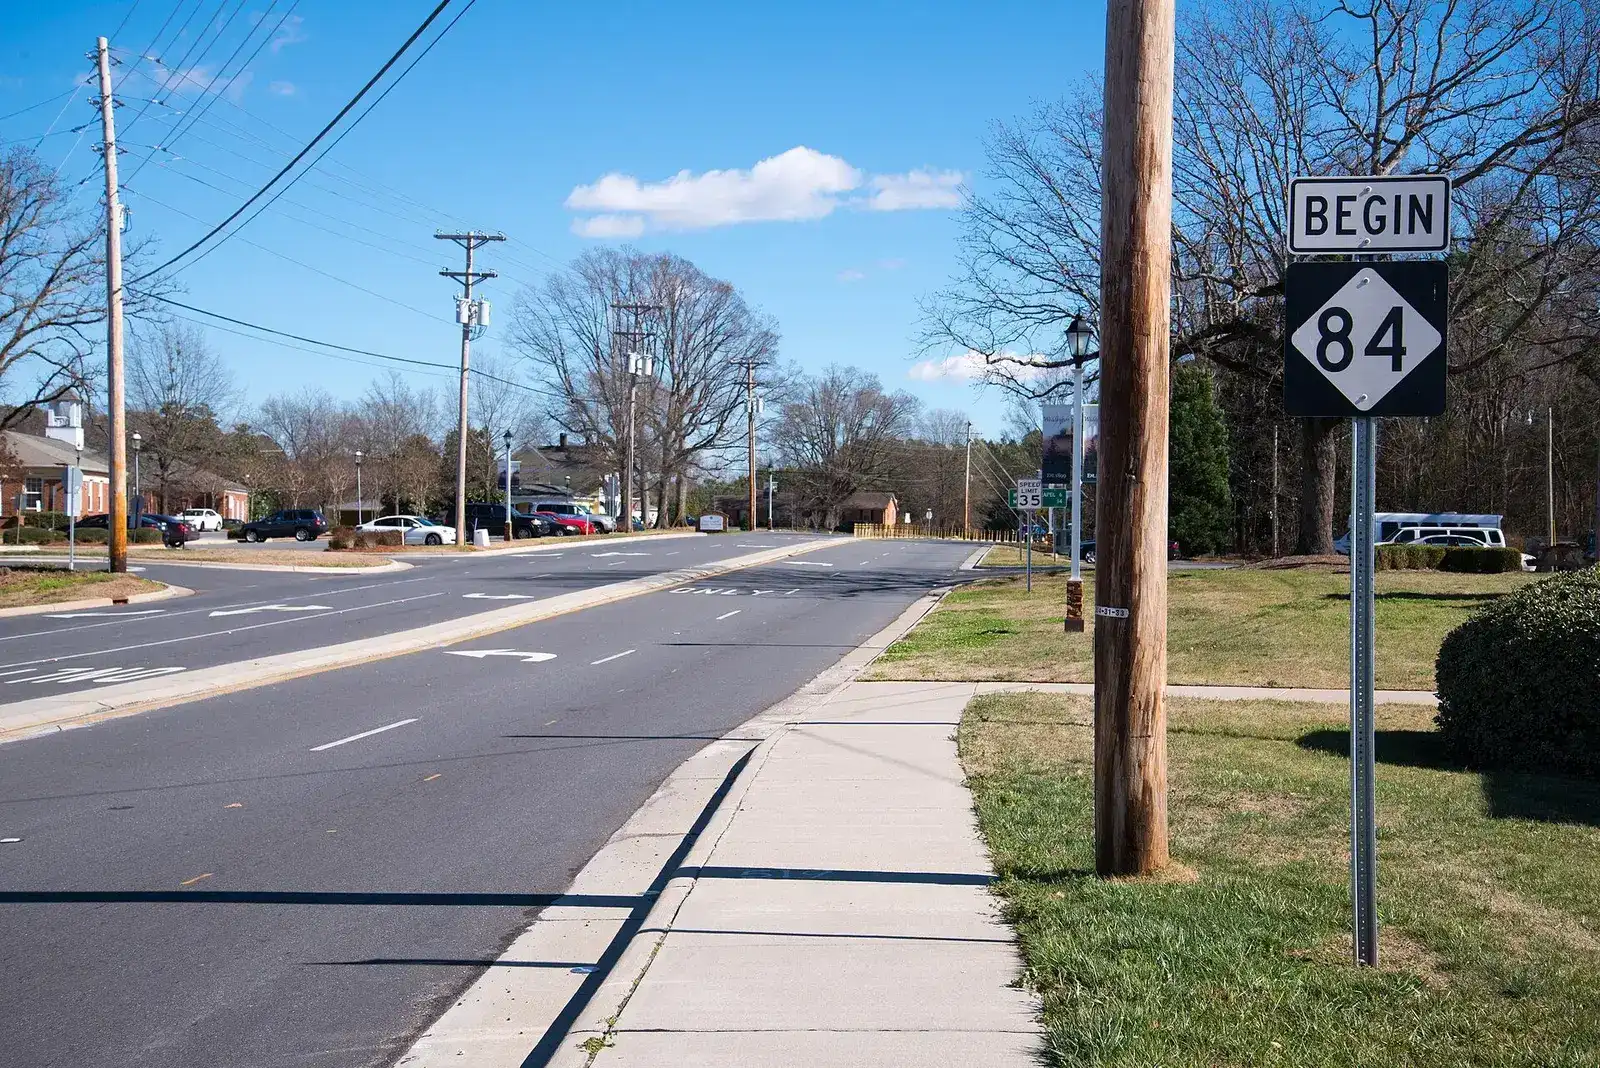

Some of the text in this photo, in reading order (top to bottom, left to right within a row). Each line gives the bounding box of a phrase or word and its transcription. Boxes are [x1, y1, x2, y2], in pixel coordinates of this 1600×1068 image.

[1305, 194, 1433, 236] BEGIN
[1316, 306, 1407, 373] 84
[1019, 495, 1040, 506] 35
